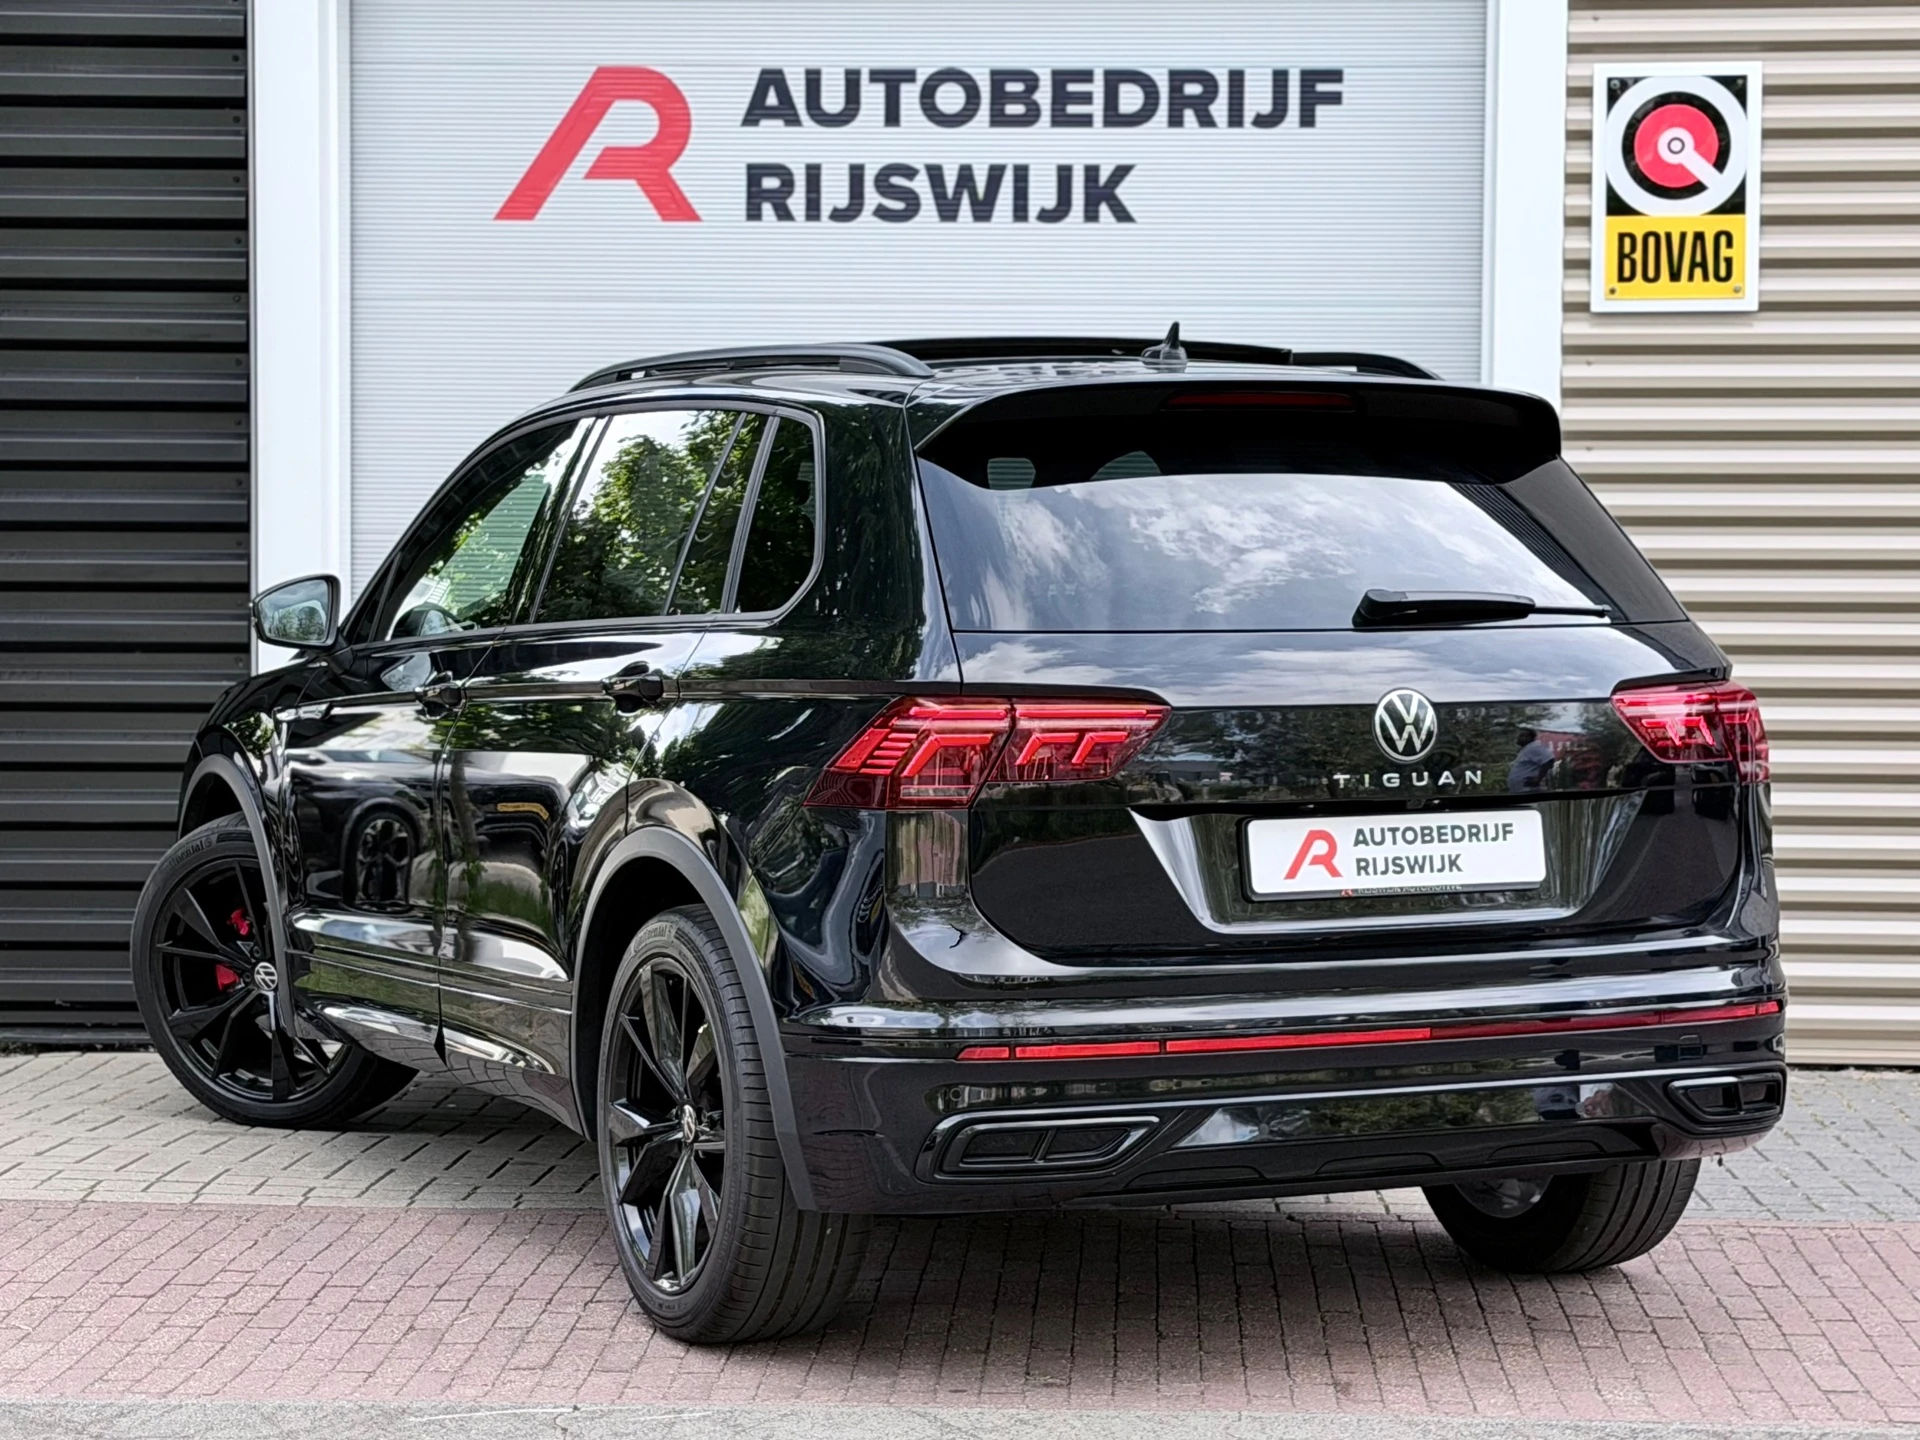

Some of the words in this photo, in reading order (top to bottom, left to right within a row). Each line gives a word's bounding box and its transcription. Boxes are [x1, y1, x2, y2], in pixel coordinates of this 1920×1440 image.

[740, 67, 1344, 129] AUTOBEDRIJF
[745, 162, 1138, 224] RIJSWIJK
[1616, 230, 1734, 283] BOVAG
[1333, 769, 1483, 788] TIGUAN
[1353, 822, 1515, 847] AUTOBEDRIJF
[1355, 853, 1464, 876] RIJSWIJK
